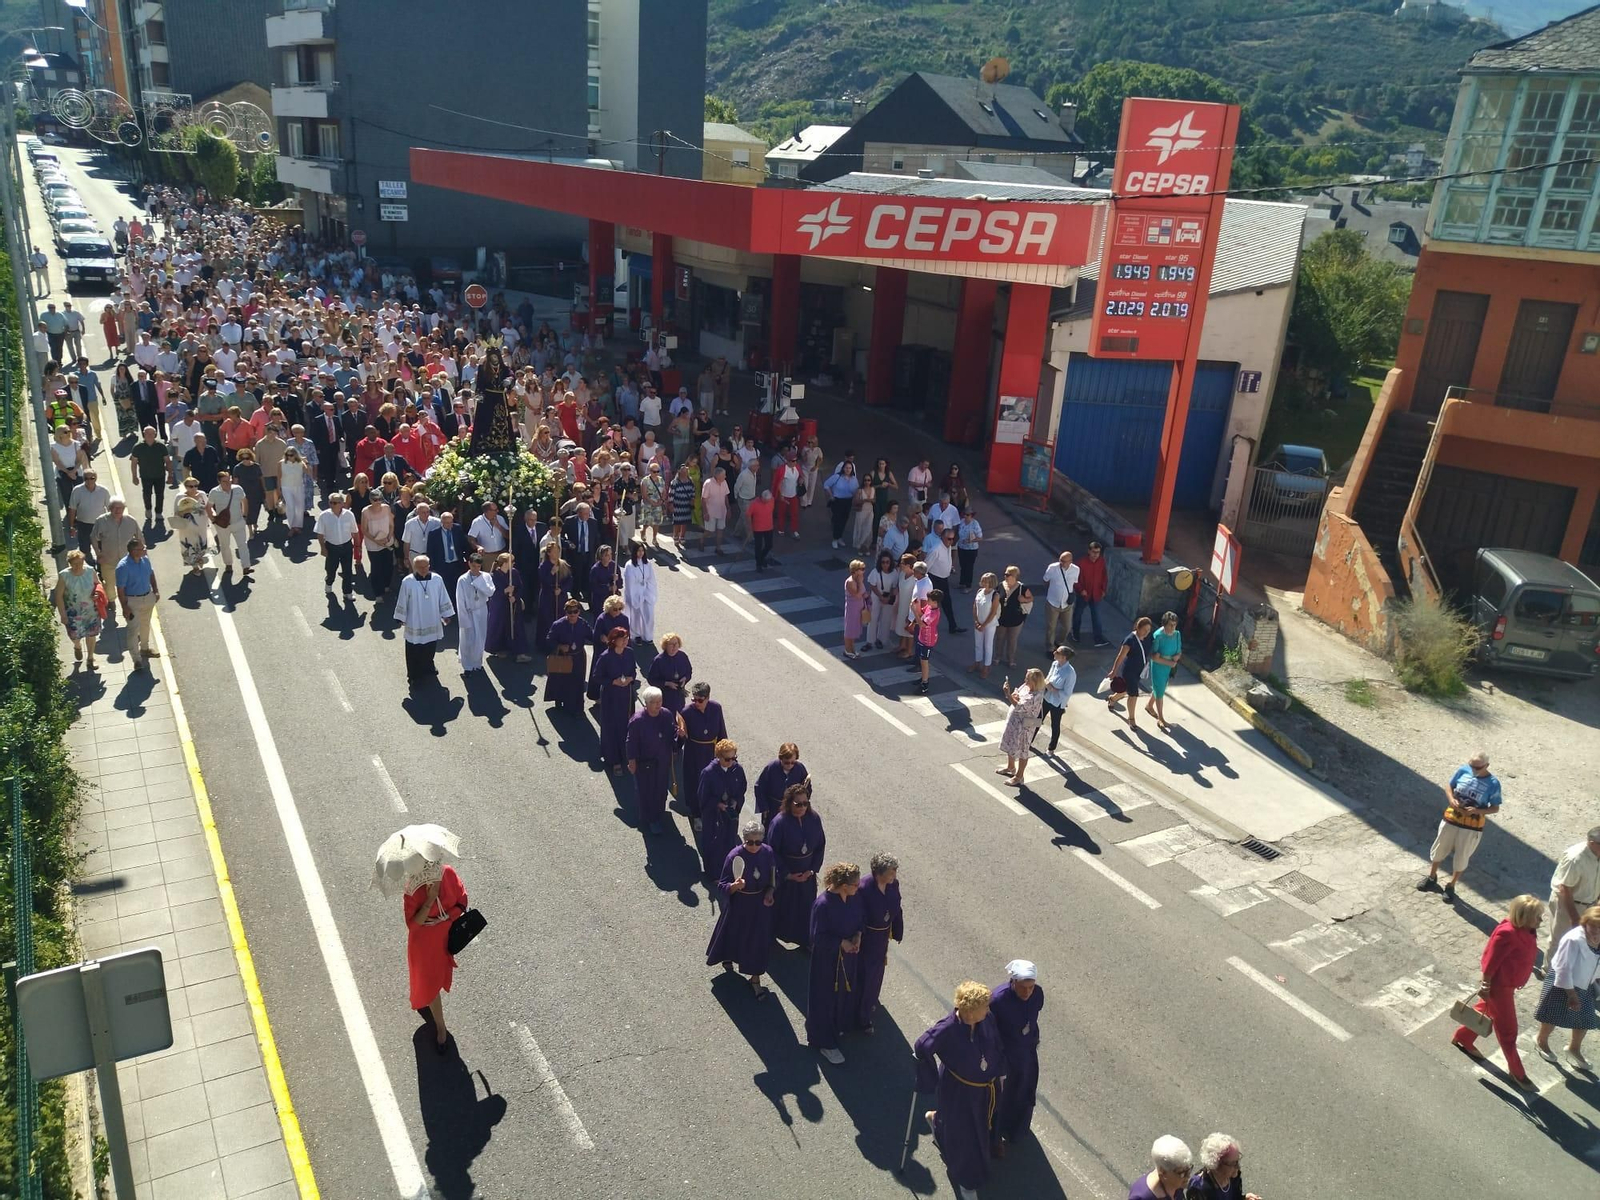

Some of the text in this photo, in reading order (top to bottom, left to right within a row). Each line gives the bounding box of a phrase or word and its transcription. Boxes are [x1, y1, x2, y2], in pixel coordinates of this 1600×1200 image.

[381, 181, 404, 189] TALLER
[1124, 171, 1209, 195] CEPSA
[864, 204, 1058, 256] CEPSA
[1178, 254, 1189, 262] 95
[1116, 264, 1151, 280] 1.949
[1161, 266, 1195, 281] 1.949
[1176, 291, 1187, 299] 98
[1106, 301, 1145, 316] 2.029
[1150, 302, 1189, 318] 2.079
